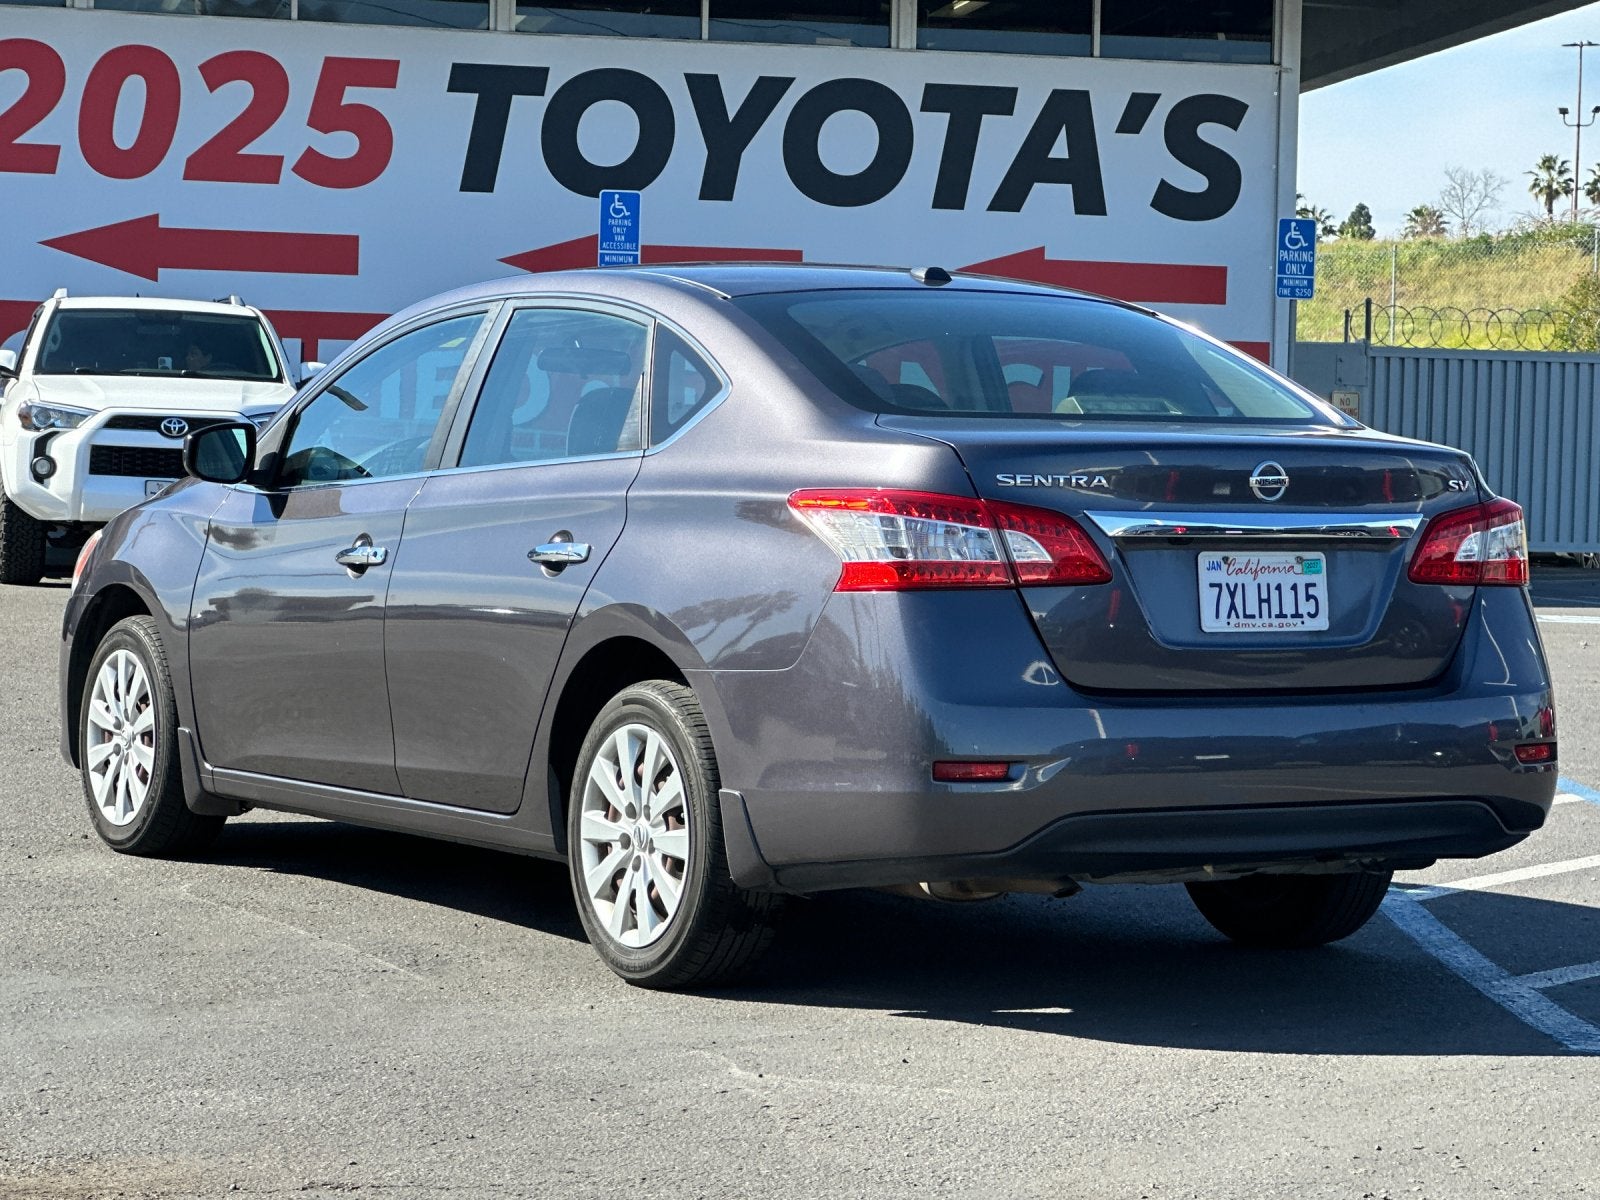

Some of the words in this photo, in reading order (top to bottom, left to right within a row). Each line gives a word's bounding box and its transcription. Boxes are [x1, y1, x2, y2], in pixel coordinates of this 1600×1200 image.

[0, 38, 399, 189] 2025
[447, 63, 1249, 222] TOYOTA'S
[608, 218, 632, 226] PARKING
[614, 234, 625, 242] VAN
[602, 242, 637, 250] ACCESSIBLE
[604, 254, 633, 263] MINIMUM
[1279, 250, 1313, 262] PARKING
[1285, 263, 1307, 275] ONLY
[1282, 278, 1308, 287] MINIMUM
[1278, 287, 1291, 296] FINE
[1295, 288, 1312, 297] $250
[1339, 397, 1351, 406] NO
[996, 473, 1110, 489] SENTRA
[1255, 478, 1287, 486] NISSAN
[1447, 480, 1470, 492] SV
[1206, 560, 1222, 571] JAN
[1226, 557, 1303, 581] California
[1208, 583, 1320, 619] 7XLH115
[1233, 620, 1299, 629] dmv.ca.gov
